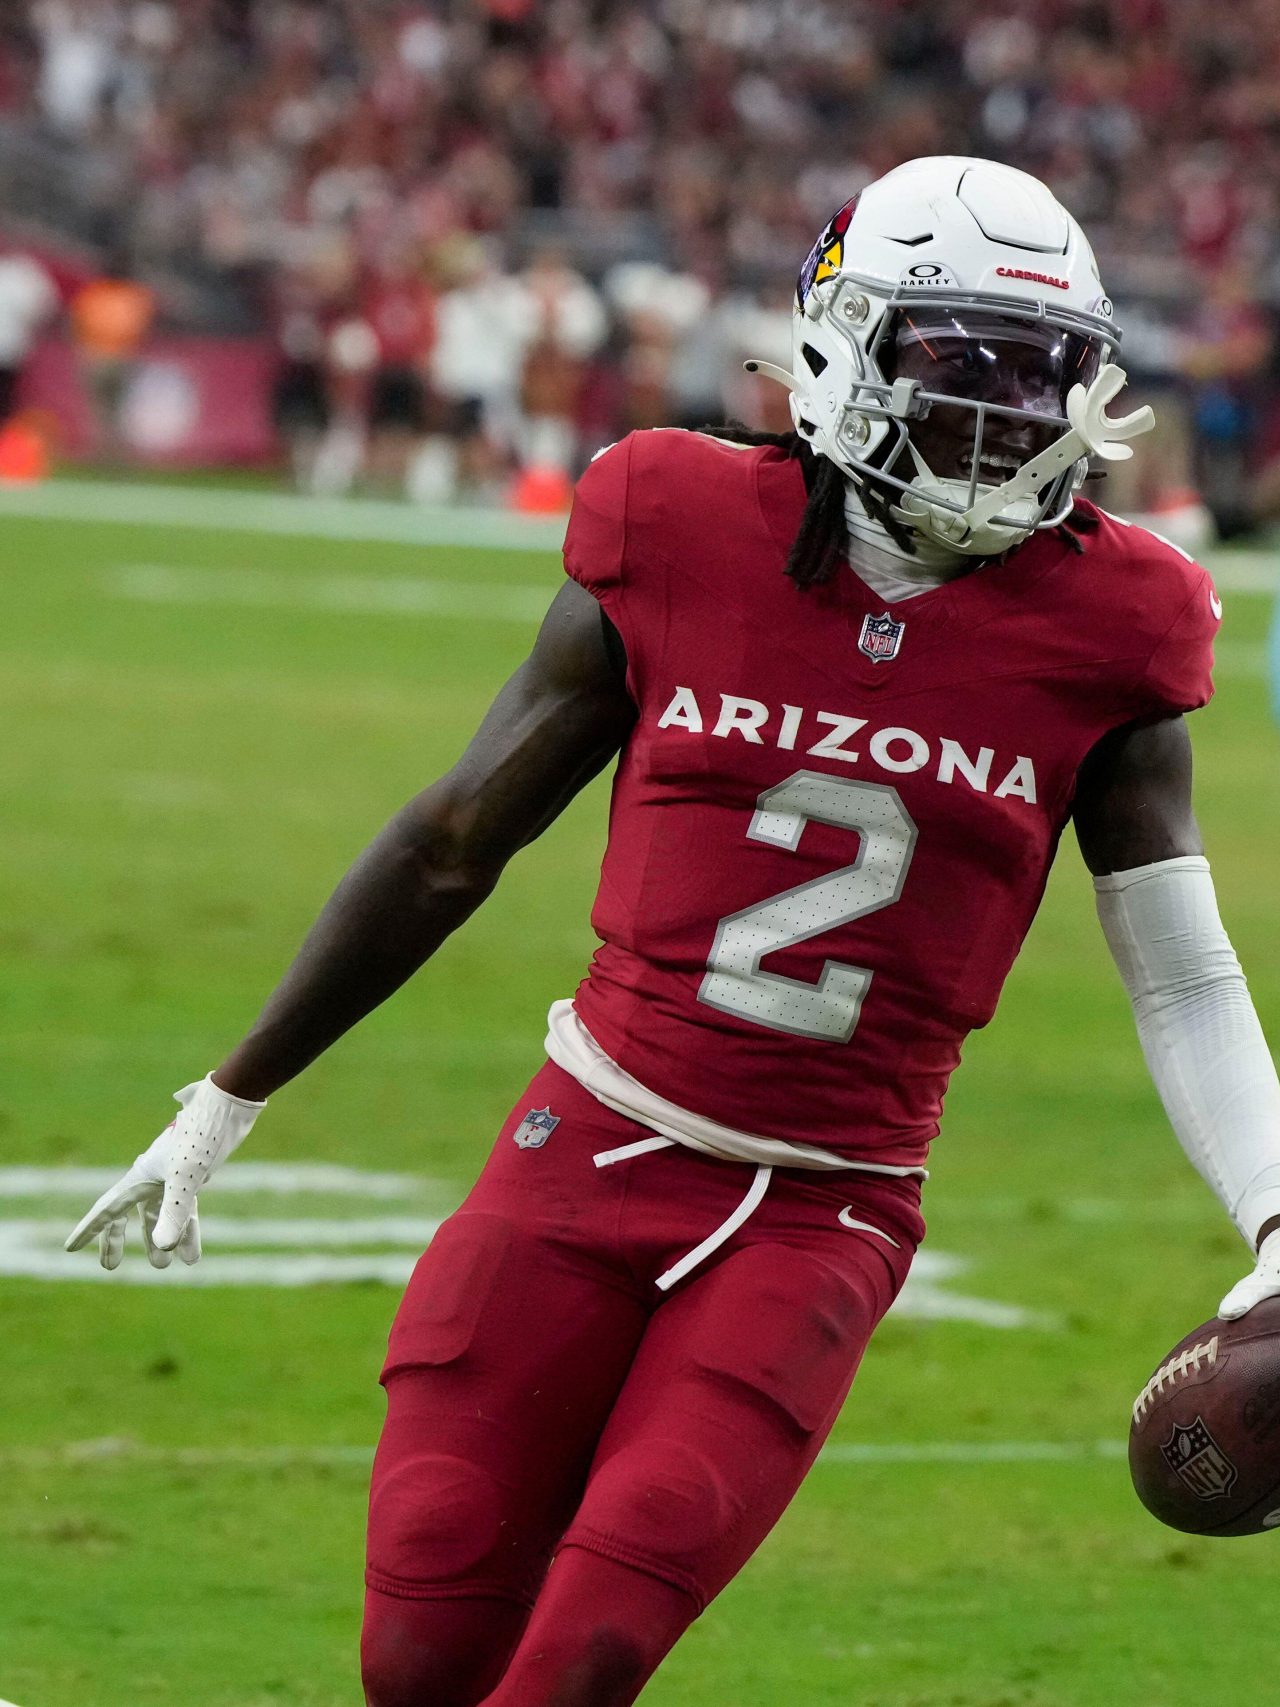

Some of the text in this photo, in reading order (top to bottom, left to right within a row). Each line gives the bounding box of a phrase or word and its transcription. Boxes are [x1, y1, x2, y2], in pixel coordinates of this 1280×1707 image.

[900, 278, 950, 286] OAKLEY
[996, 267, 1070, 289] CARDINALS
[864, 632, 893, 655] NFL
[657, 686, 1038, 804] ARIZONA
[696, 768, 920, 1044] 2
[1180, 1450, 1229, 1496] NFL
